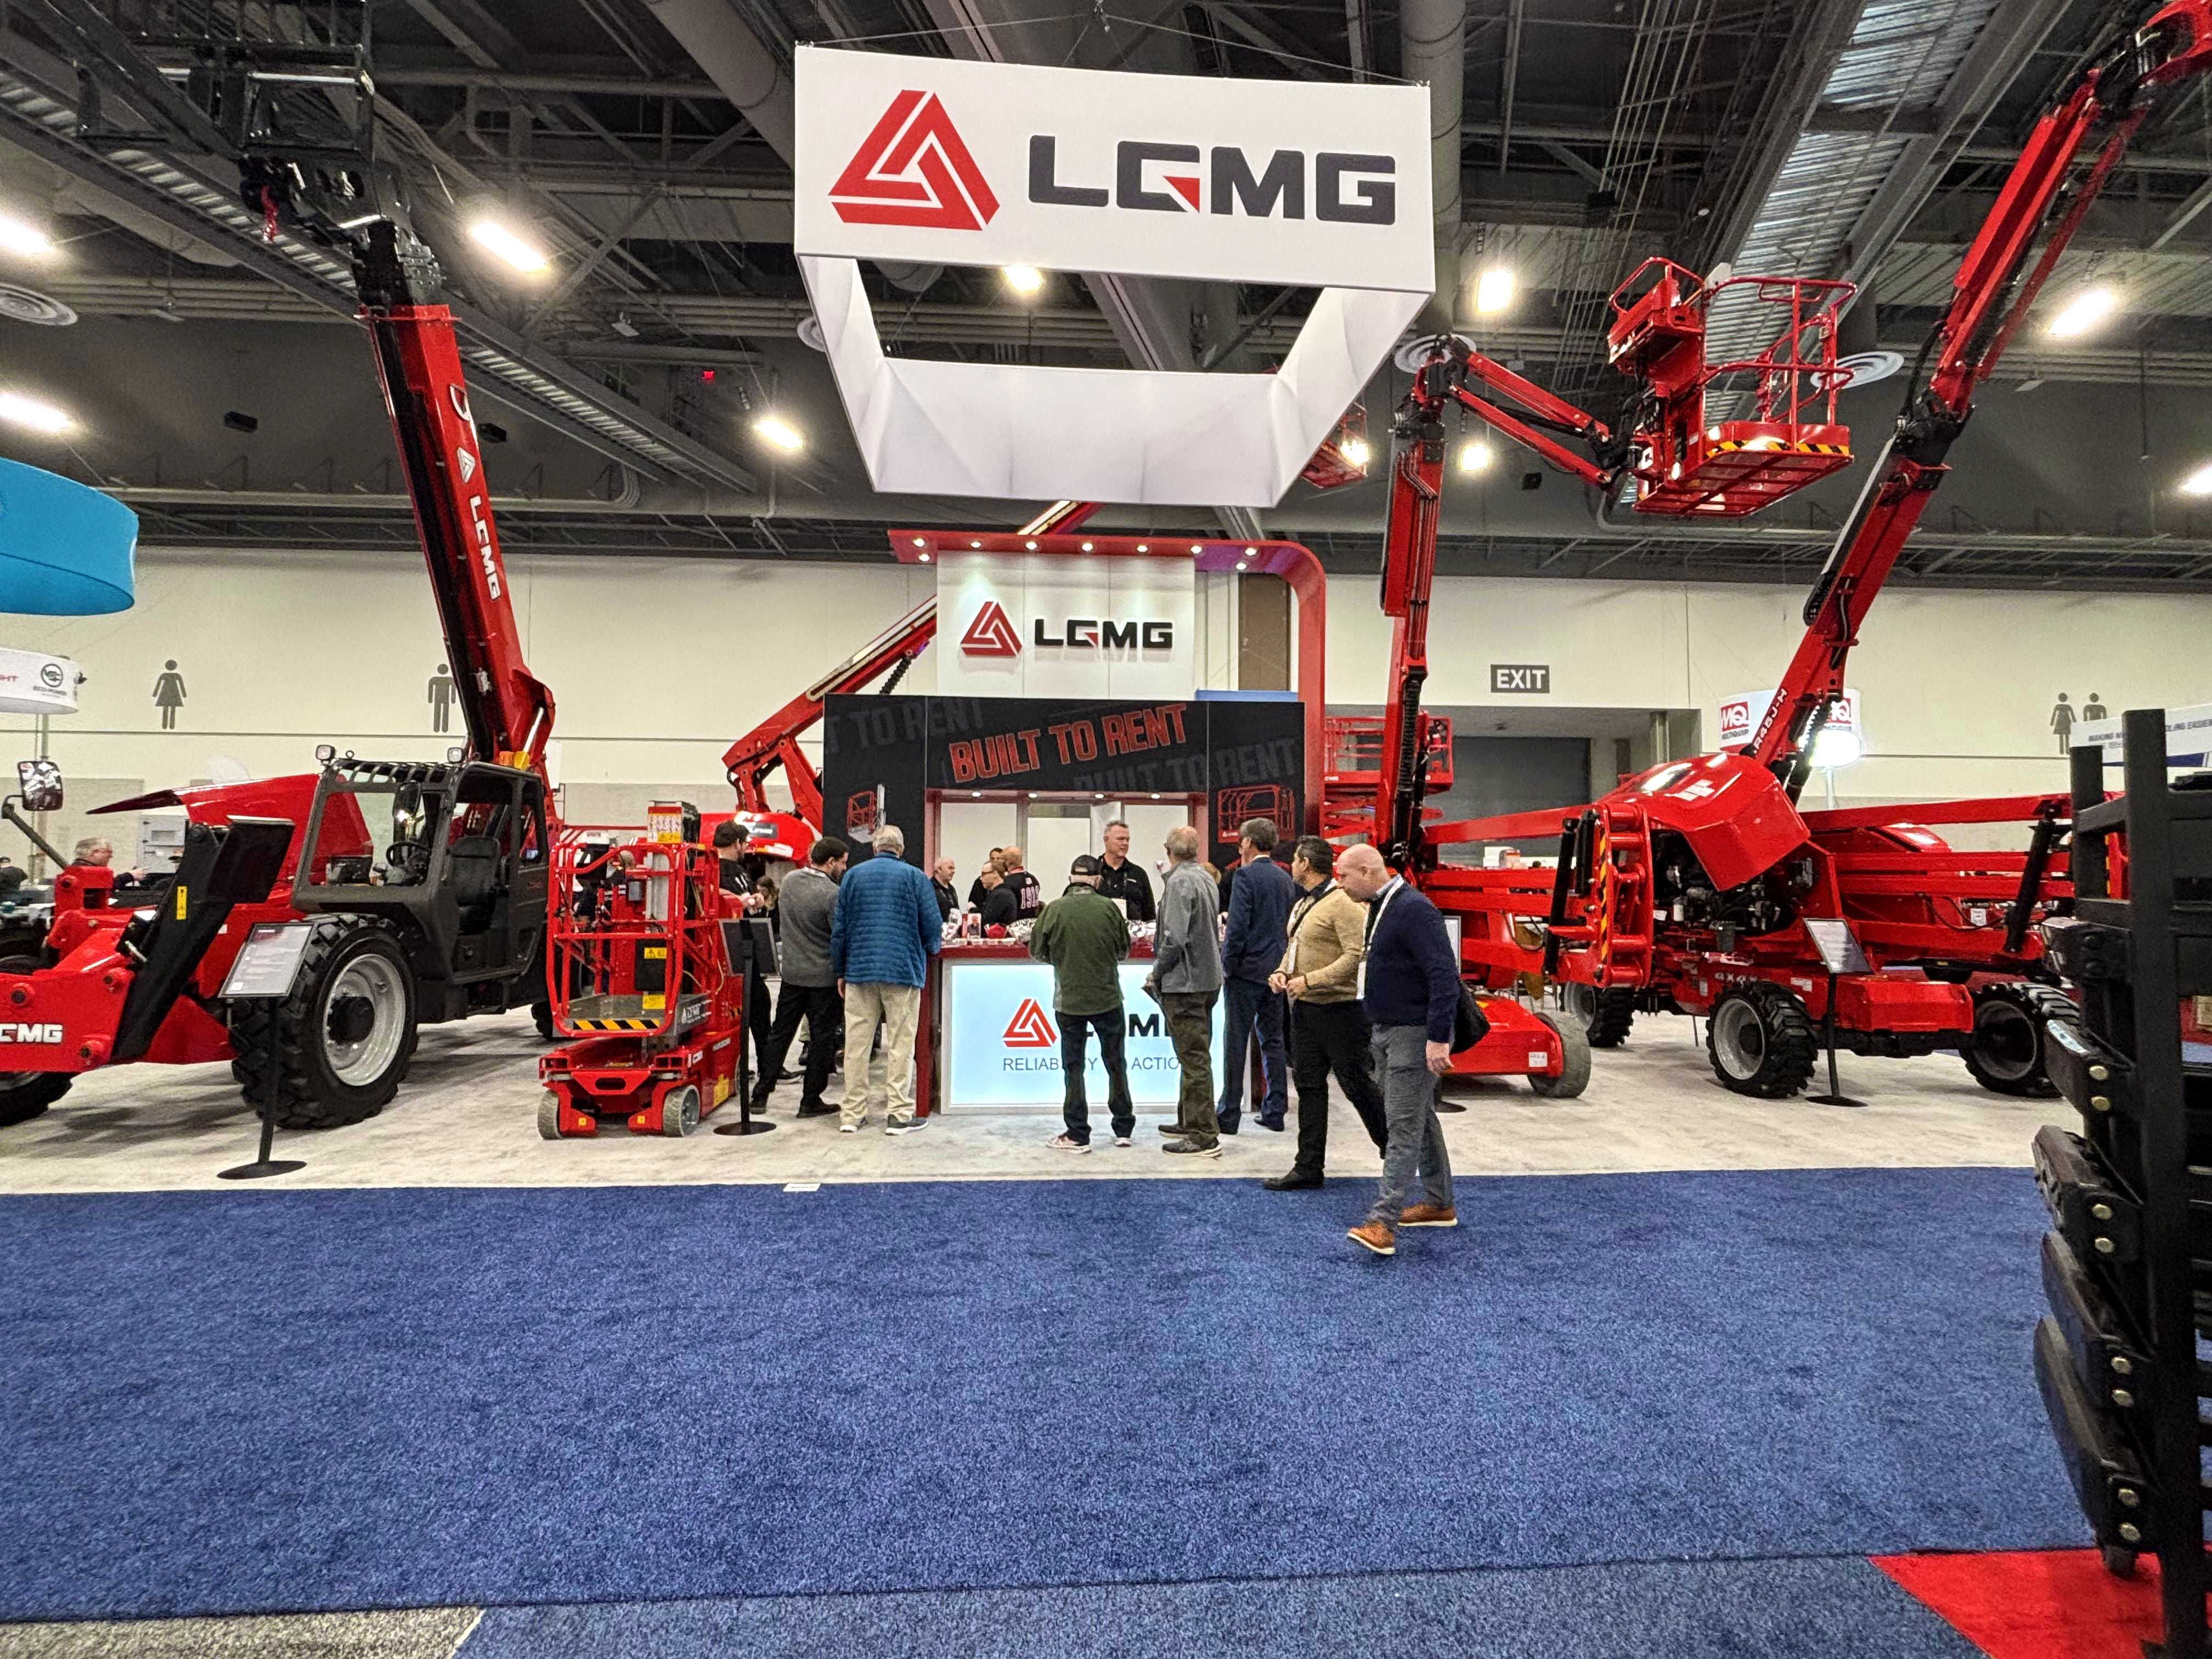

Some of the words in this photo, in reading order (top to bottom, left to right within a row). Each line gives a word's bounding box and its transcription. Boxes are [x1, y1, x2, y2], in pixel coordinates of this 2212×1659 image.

[1029, 135, 1396, 225] LGMG
[470, 495, 501, 600] LGMG
[1035, 619, 1173, 648] LGMG
[1497, 669, 1546, 689] EXIT
[1722, 706, 1750, 729] MQ
[949, 729, 1041, 783] BUILT
[1048, 720, 1097, 765] TO
[1102, 703, 1187, 756] RENT
[1215, 737, 1295, 786] RENT
[0, 1023, 63, 1042] GMG
[1003, 1058, 1097, 1070] RELIABY
[1131, 1057, 1180, 1070] ACTIO
